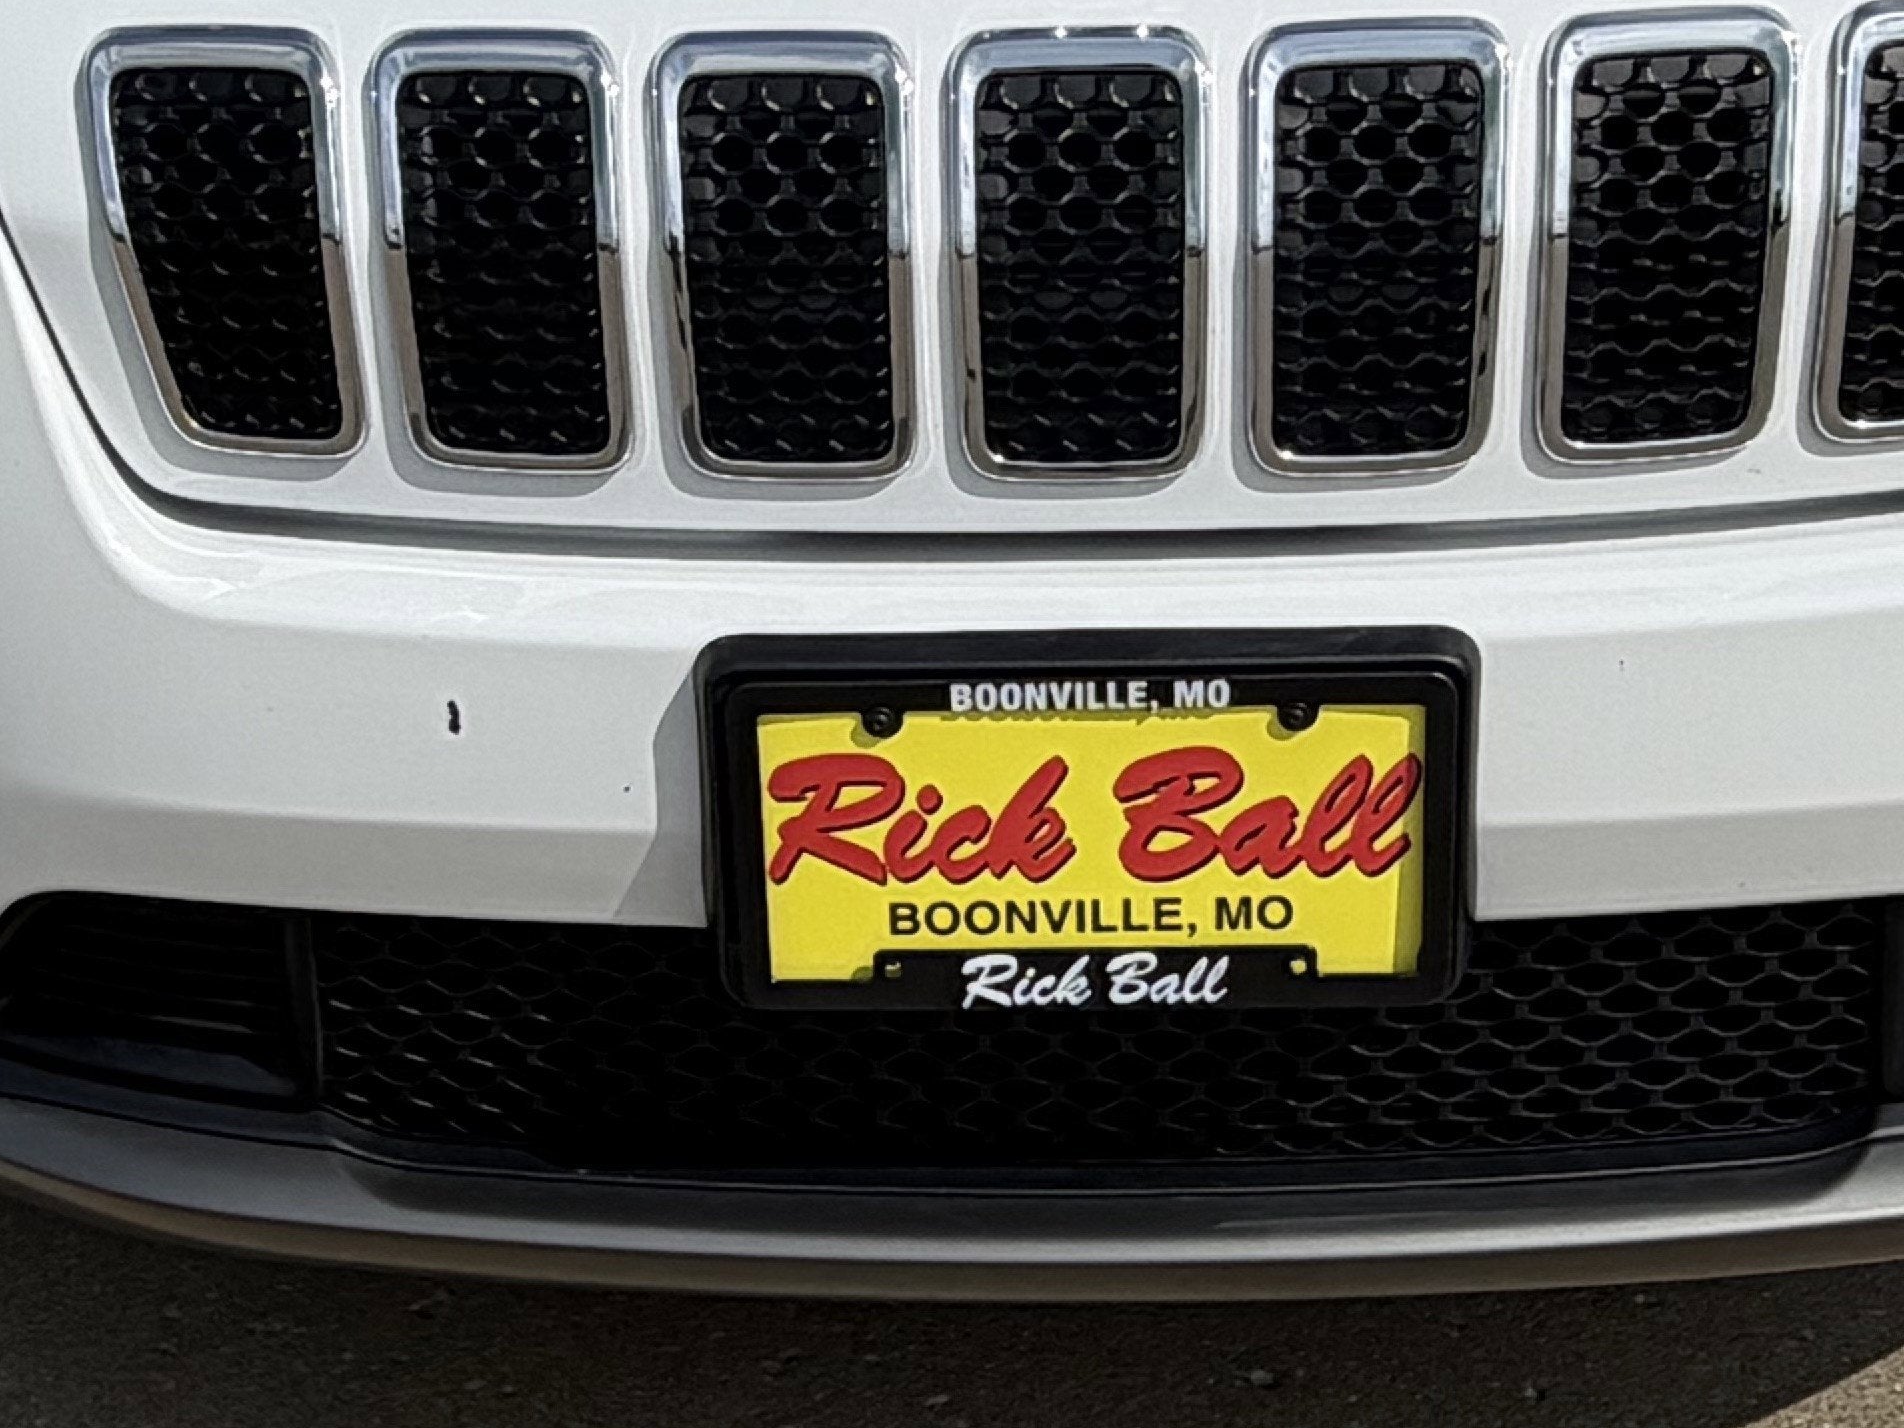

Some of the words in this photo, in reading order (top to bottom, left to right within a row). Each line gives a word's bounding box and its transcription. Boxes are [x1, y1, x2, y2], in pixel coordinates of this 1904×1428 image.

[948, 680, 1163, 713] BOONVILLE,
[1172, 678, 1232, 710] MO
[768, 752, 1076, 884] Rick
[1112, 745, 1422, 883] Ball
[888, 897, 1198, 939] BOONVILLE,
[1214, 895, 1295, 932] MO
[960, 956, 1093, 1011] Rick
[1107, 954, 1230, 1006] Ball
